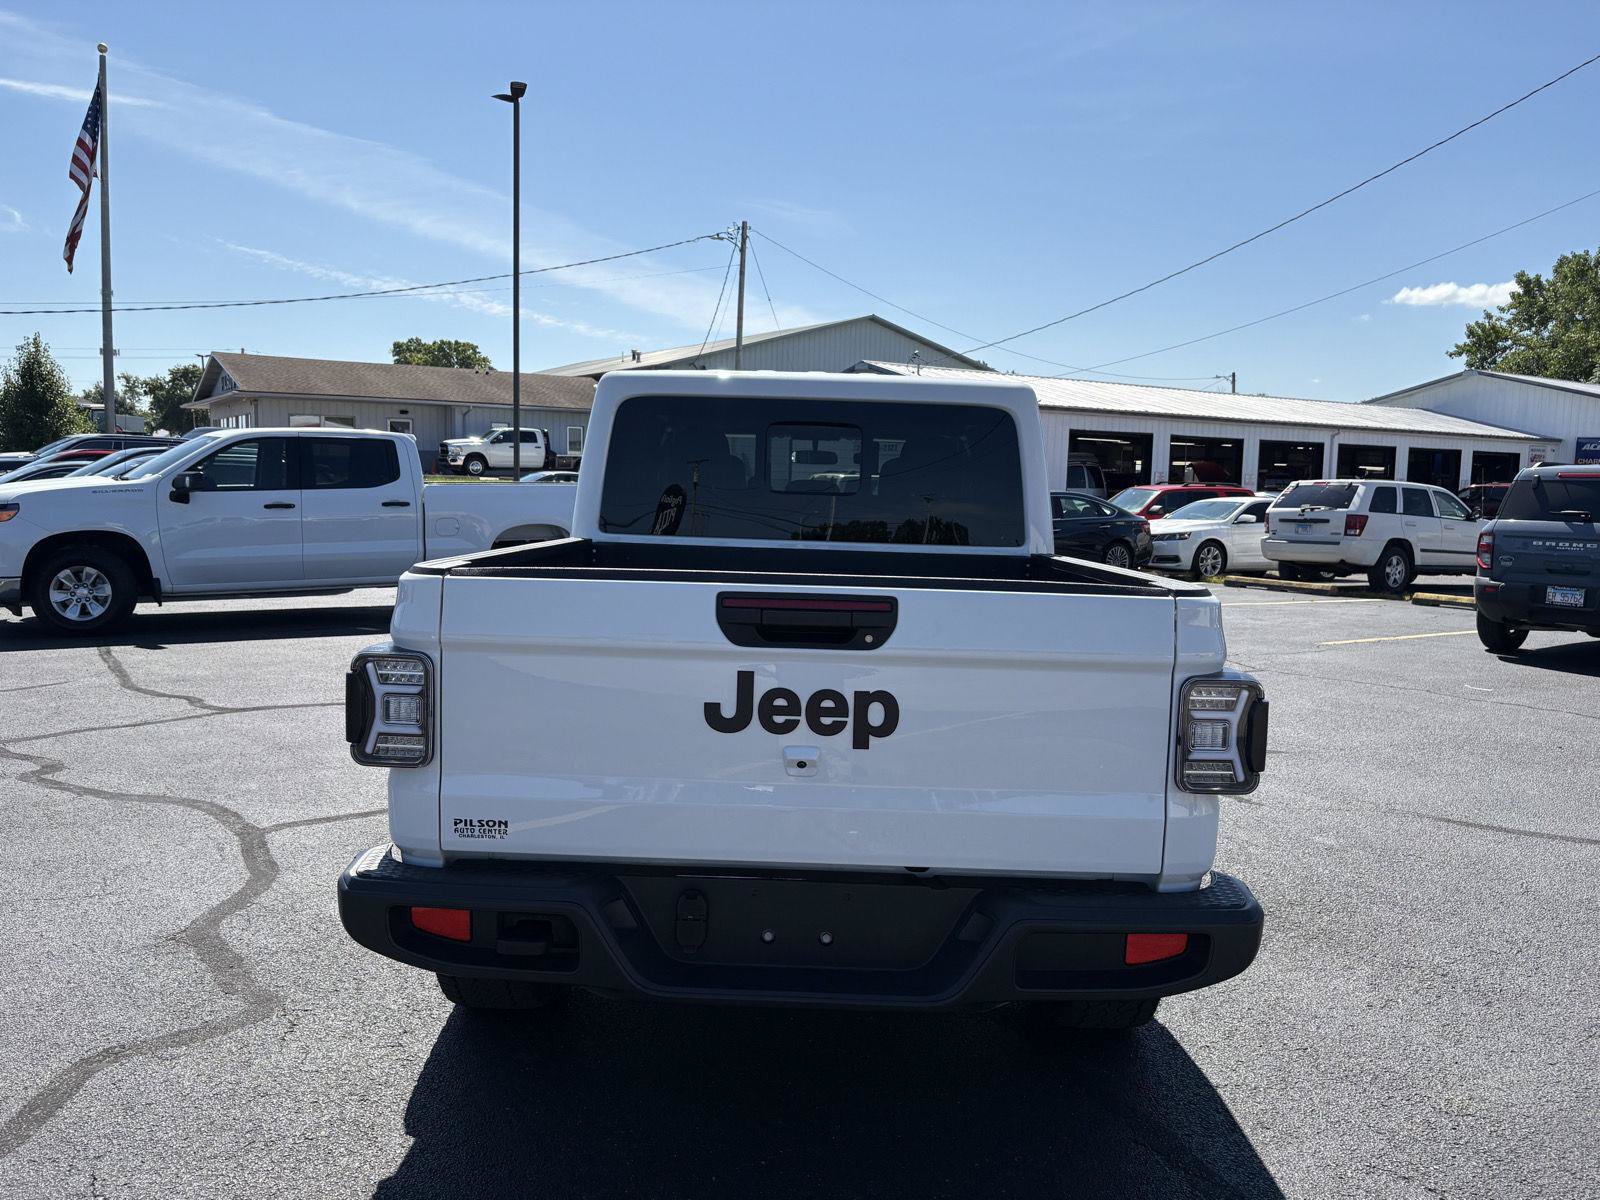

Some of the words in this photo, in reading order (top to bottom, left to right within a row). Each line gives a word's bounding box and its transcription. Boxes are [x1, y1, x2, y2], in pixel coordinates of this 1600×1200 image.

[704, 670, 900, 750] Jeep
[453, 818, 508, 828] PILSON
[478, 828, 508, 836] CENTER
